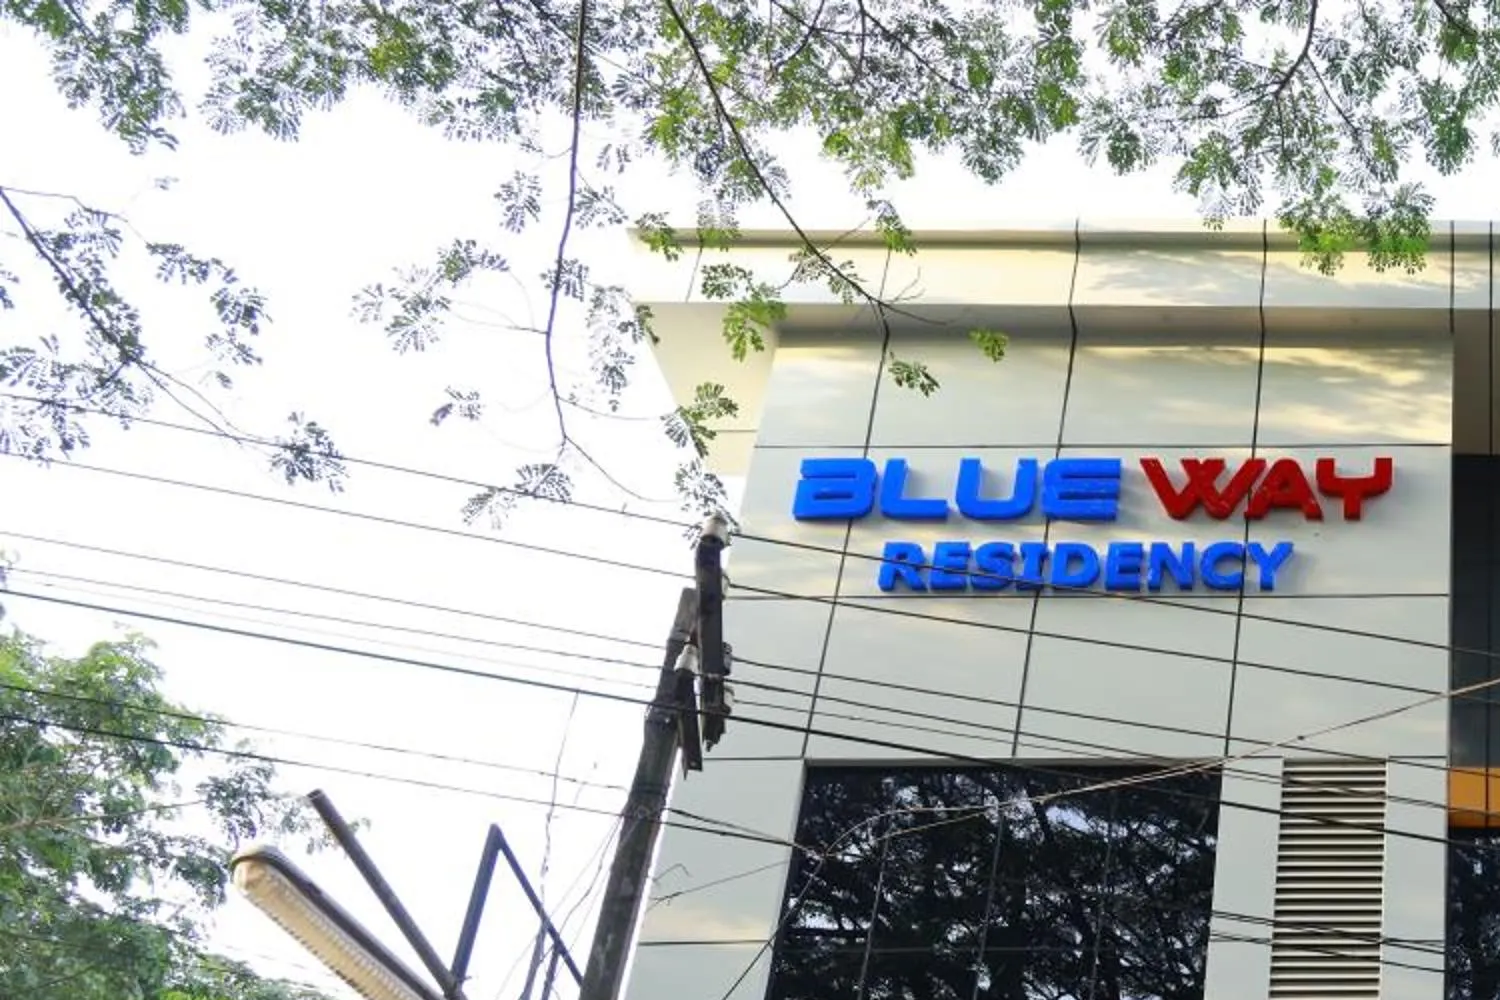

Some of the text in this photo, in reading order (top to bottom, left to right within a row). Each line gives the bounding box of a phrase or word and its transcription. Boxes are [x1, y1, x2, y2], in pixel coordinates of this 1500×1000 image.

[793, 457, 1394, 521] BLUE WAY
[877, 541, 1294, 592] RESIDENCY
